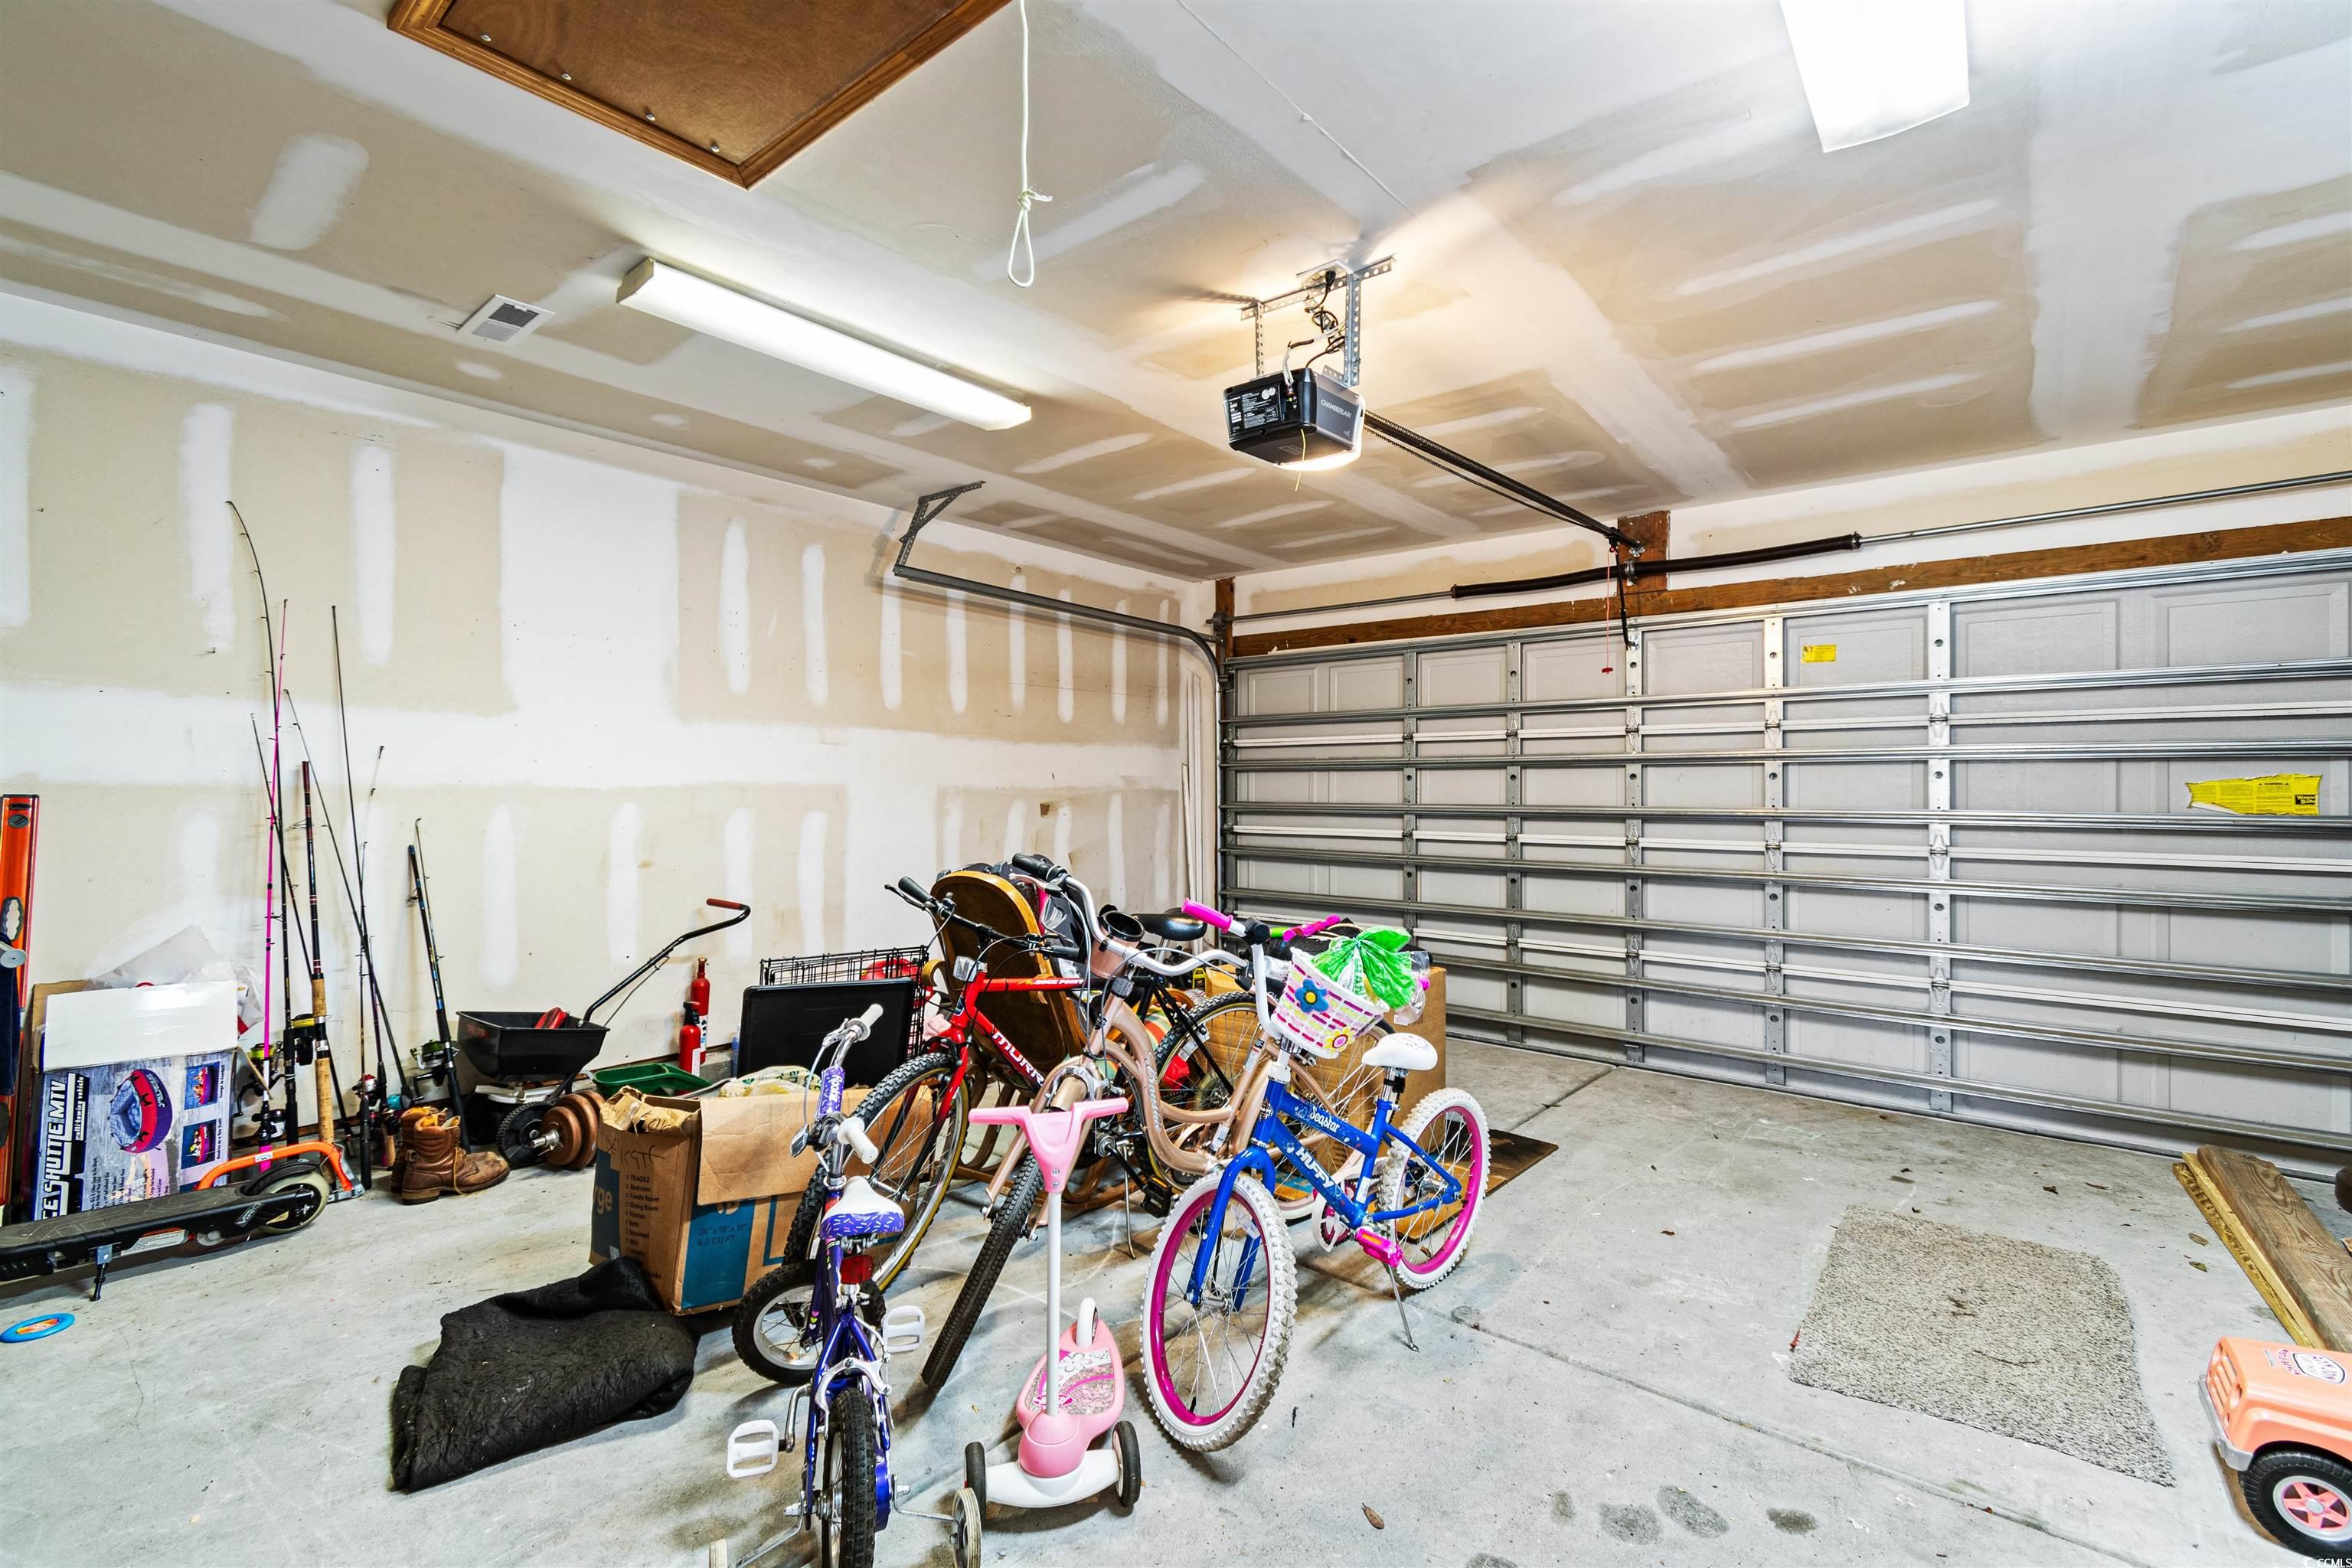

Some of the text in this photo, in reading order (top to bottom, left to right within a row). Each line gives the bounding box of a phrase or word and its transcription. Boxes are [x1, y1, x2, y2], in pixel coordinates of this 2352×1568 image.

[1321, 399, 1352, 419] CHAMBERLAIN
[992, 1031, 1045, 1086] MURR
[48, 1080, 67, 1119] MTV
[828, 1074, 843, 1102] Rookie
[1310, 1106, 1340, 1133] Seastar
[44, 1122, 72, 1194] SHUTTLE
[1295, 1146, 1334, 1188] HUFFY
[630, 1174, 650, 1183] FRAGILE
[235, 1202, 263, 1225] VIRO
[712, 1236, 724, 1245] CU
[726, 1234, 736, 1243] FT
